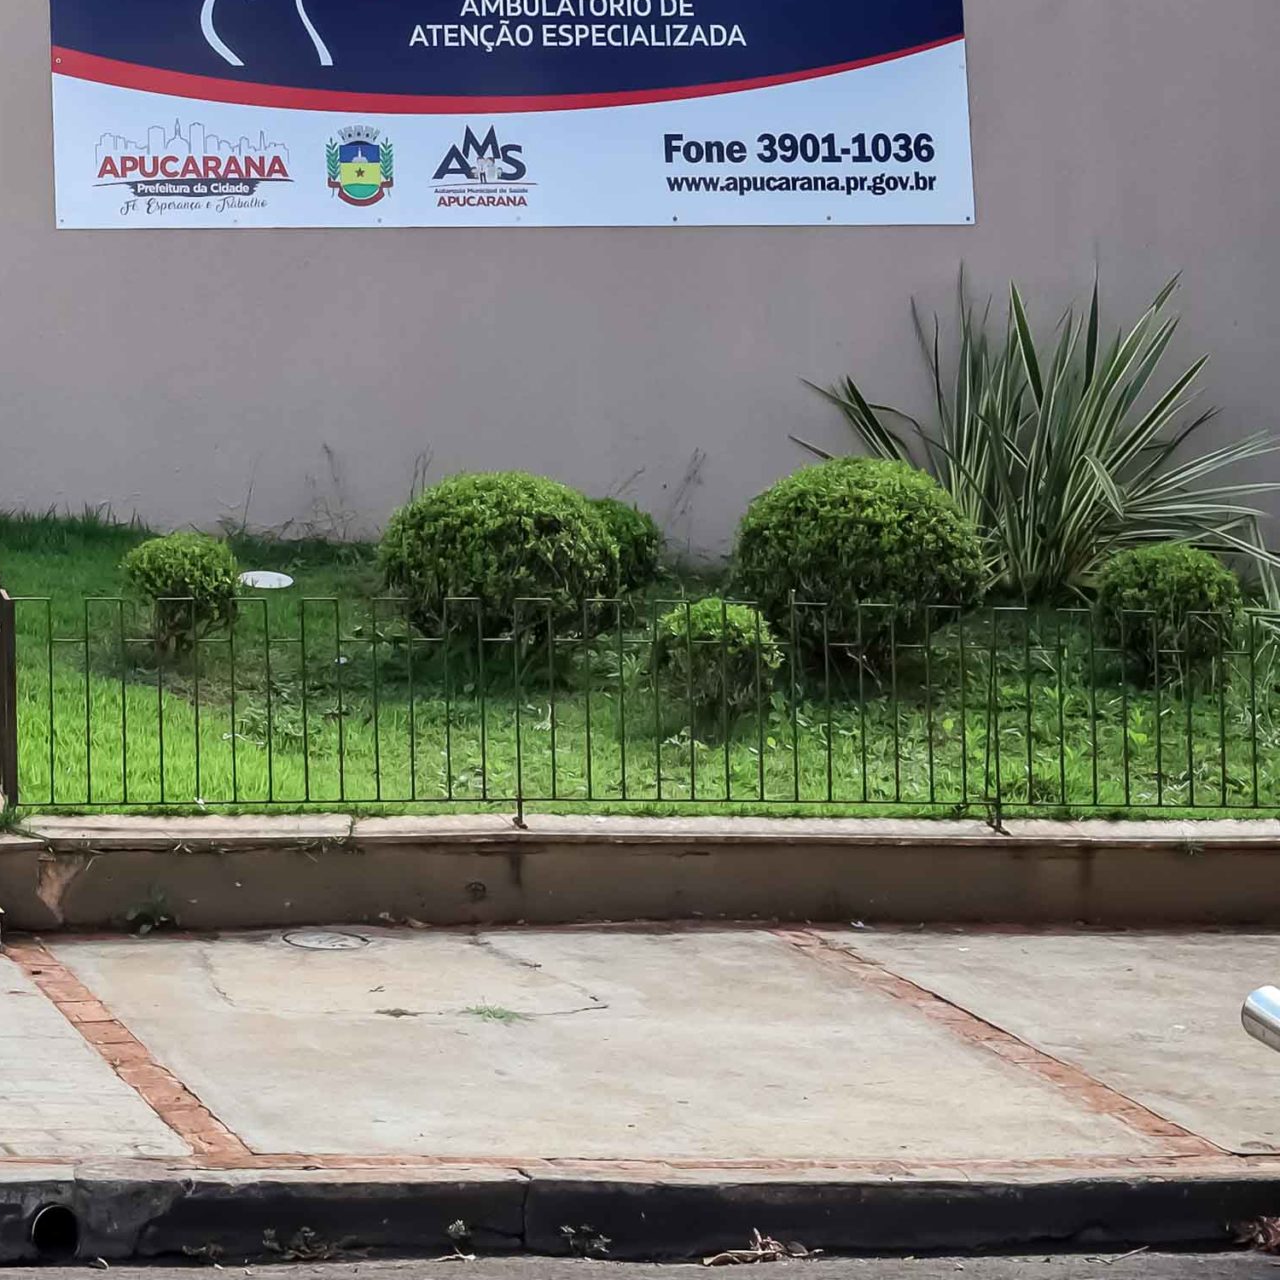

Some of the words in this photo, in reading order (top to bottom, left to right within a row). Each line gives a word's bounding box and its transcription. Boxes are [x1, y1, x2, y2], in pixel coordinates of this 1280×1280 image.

[408, 20, 534, 53] ATENÇÃO
[542, 24, 747, 47] ESPECIALIZADA
[431, 124, 527, 181] AMS
[663, 133, 748, 164] Fone
[756, 132, 936, 164] 3901-1036
[97, 155, 289, 179] APUCARANA
[136, 182, 191, 194] Prefeitura
[193, 182, 208, 194] da
[210, 182, 250, 194] Cidade
[666, 171, 937, 196] www.apucarana.pr.gov.br
[146, 197, 202, 216] Esperança
[215, 195, 269, 213] Trabalho
[437, 195, 528, 207] APUCARANA
